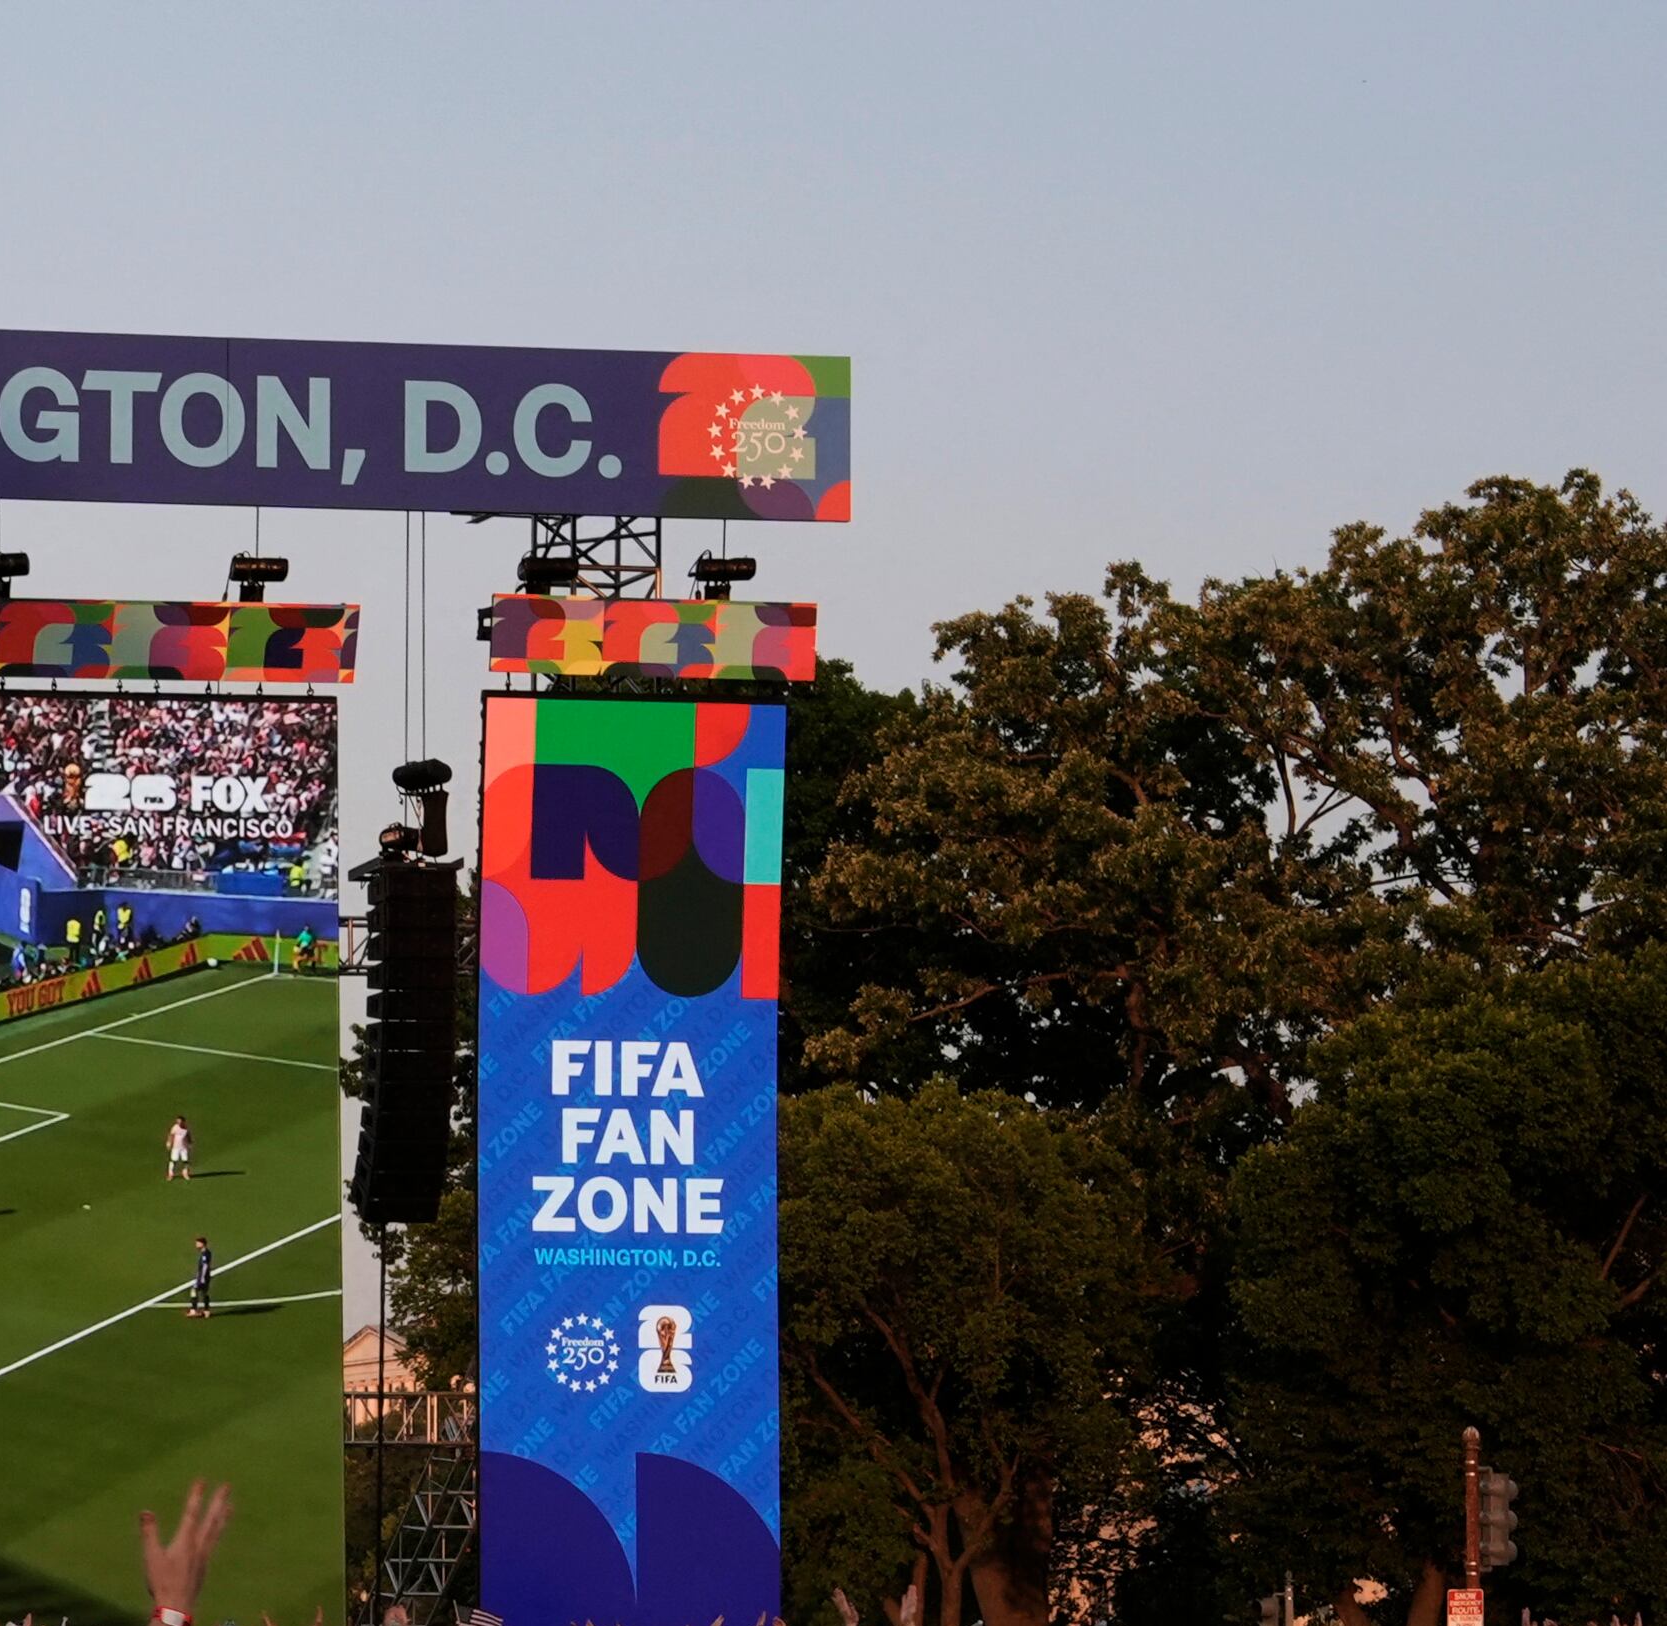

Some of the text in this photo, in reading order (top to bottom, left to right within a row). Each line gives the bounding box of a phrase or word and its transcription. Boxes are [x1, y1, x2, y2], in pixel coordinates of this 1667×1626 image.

[404, 380, 622, 479] D.C.
[729, 418, 785, 430] Freedom
[729, 431, 786, 462] 250
[191, 776, 269, 812] FOX
[108, 817, 154, 837] SAN
[163, 817, 294, 839] FRANCISCO
[7, 979, 66, 1017] YOU GOT
[551, 1040, 705, 1098] FIFA
[487, 1099, 544, 1159] ZONE
[562, 1108, 694, 1165] FAN
[702, 1119, 746, 1164] FAN
[532, 1176, 724, 1234] ZONE
[534, 1248, 721, 1269] WASHINGTON, D.C.
[499, 1288, 545, 1337] FIFA
[561, 1337, 604, 1347] Freedom
[562, 1347, 605, 1370] 250
[654, 1375, 678, 1384] FIFA
[675, 1386, 717, 1434] FAN
[710, 1336, 766, 1391] ZONE
[587, 1383, 636, 1432] FIFA
